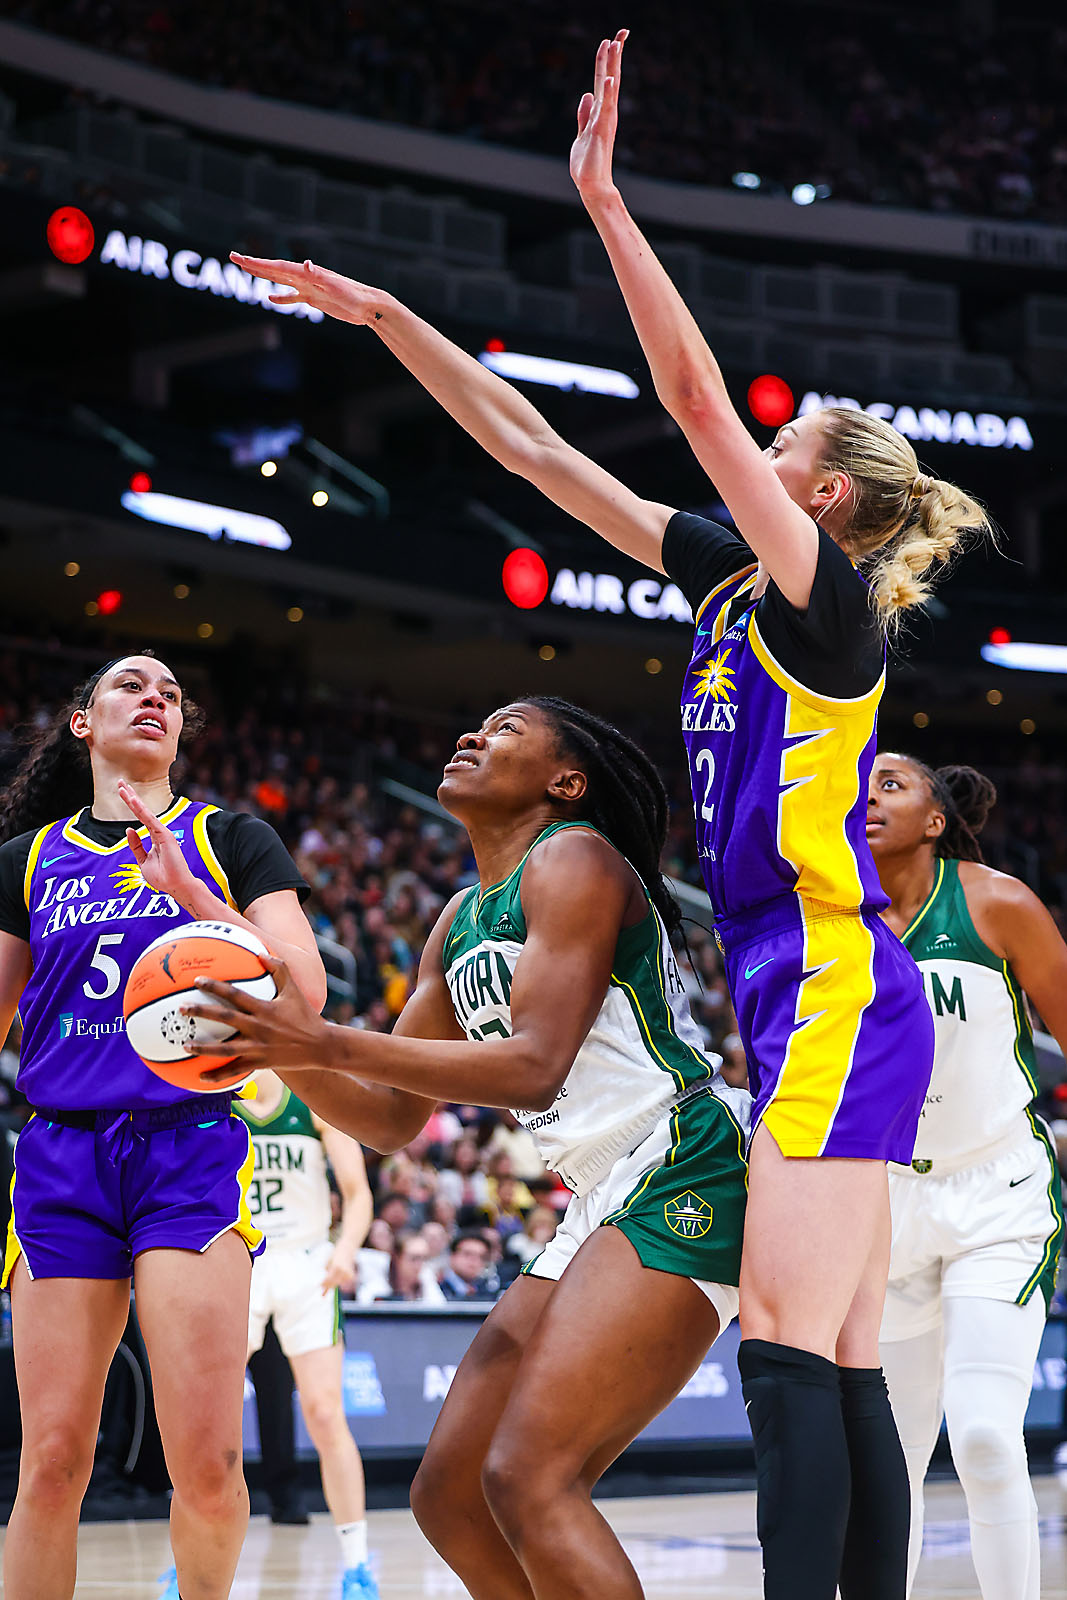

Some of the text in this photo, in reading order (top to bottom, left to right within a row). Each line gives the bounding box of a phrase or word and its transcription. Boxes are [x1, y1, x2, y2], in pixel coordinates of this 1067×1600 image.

[101, 230, 170, 280] AIR
[550, 568, 695, 624] AIR CA
[680, 702, 739, 732] ELES
[34, 875, 96, 914] LOS
[41, 881, 181, 939] ANGELES
[82, 933, 125, 1000] 5
[75, 1015, 128, 1040] EquiT
[251, 1178, 284, 1215] 32
